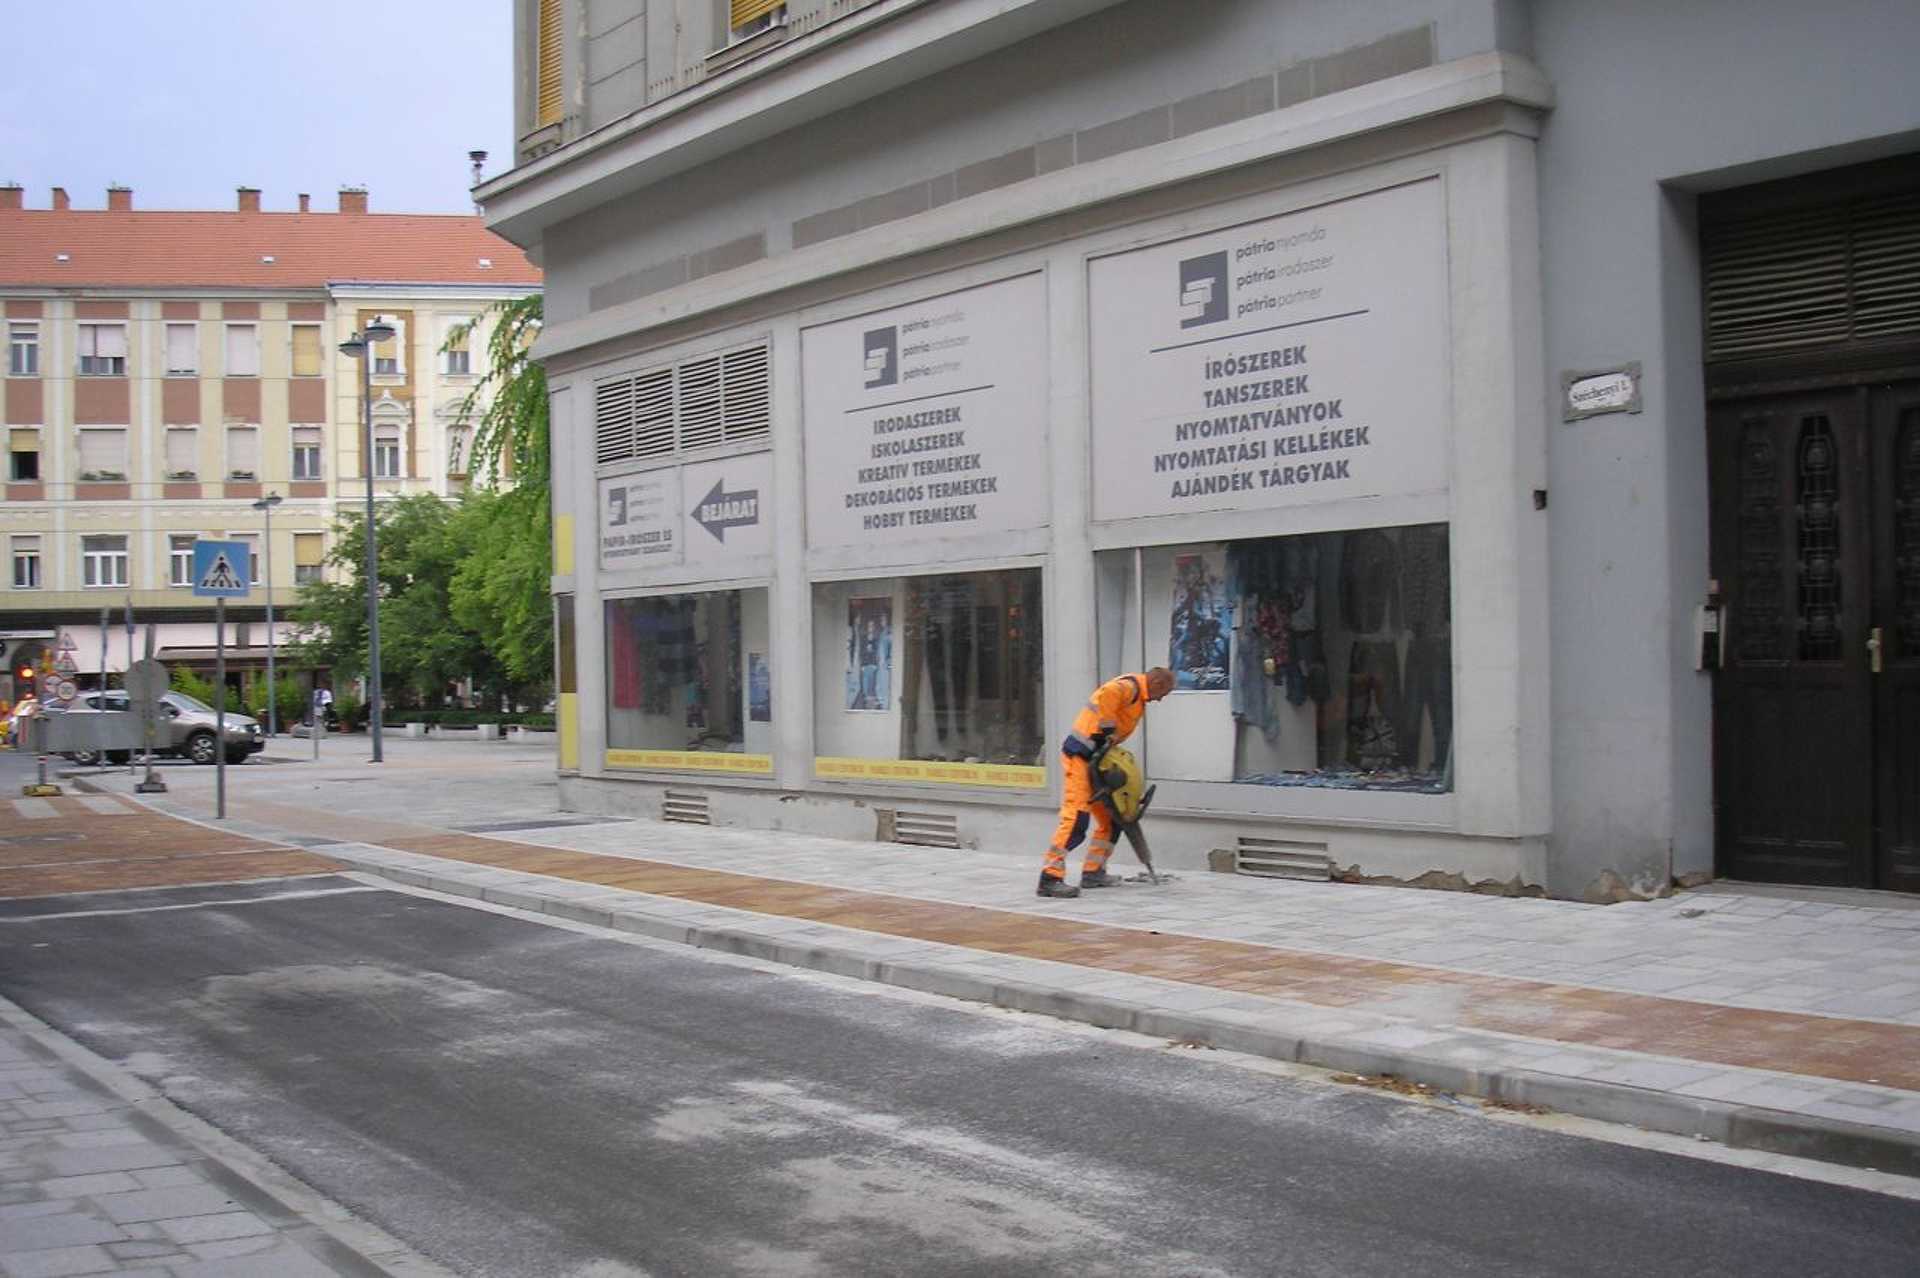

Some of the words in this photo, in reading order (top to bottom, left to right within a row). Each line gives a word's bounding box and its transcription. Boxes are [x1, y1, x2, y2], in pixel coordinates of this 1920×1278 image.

[1205, 345, 1308, 380] ÍRÓSZEREK
[1203, 374, 1309, 409] TANSZEREK
[873, 406, 961, 435] IRODASZEREK
[1175, 399, 1344, 442] NYOMTATVÁNYOK
[871, 430, 966, 459] ISKOLASZEREK
[1153, 439, 1267, 473] NYOMTATÁSI
[1273, 425, 1371, 458] KELLÉKEK
[1170, 466, 1254, 499] AJÁNDÉK
[1260, 458, 1351, 488] TÁRGYAK
[863, 511, 905, 530] HOBBY
